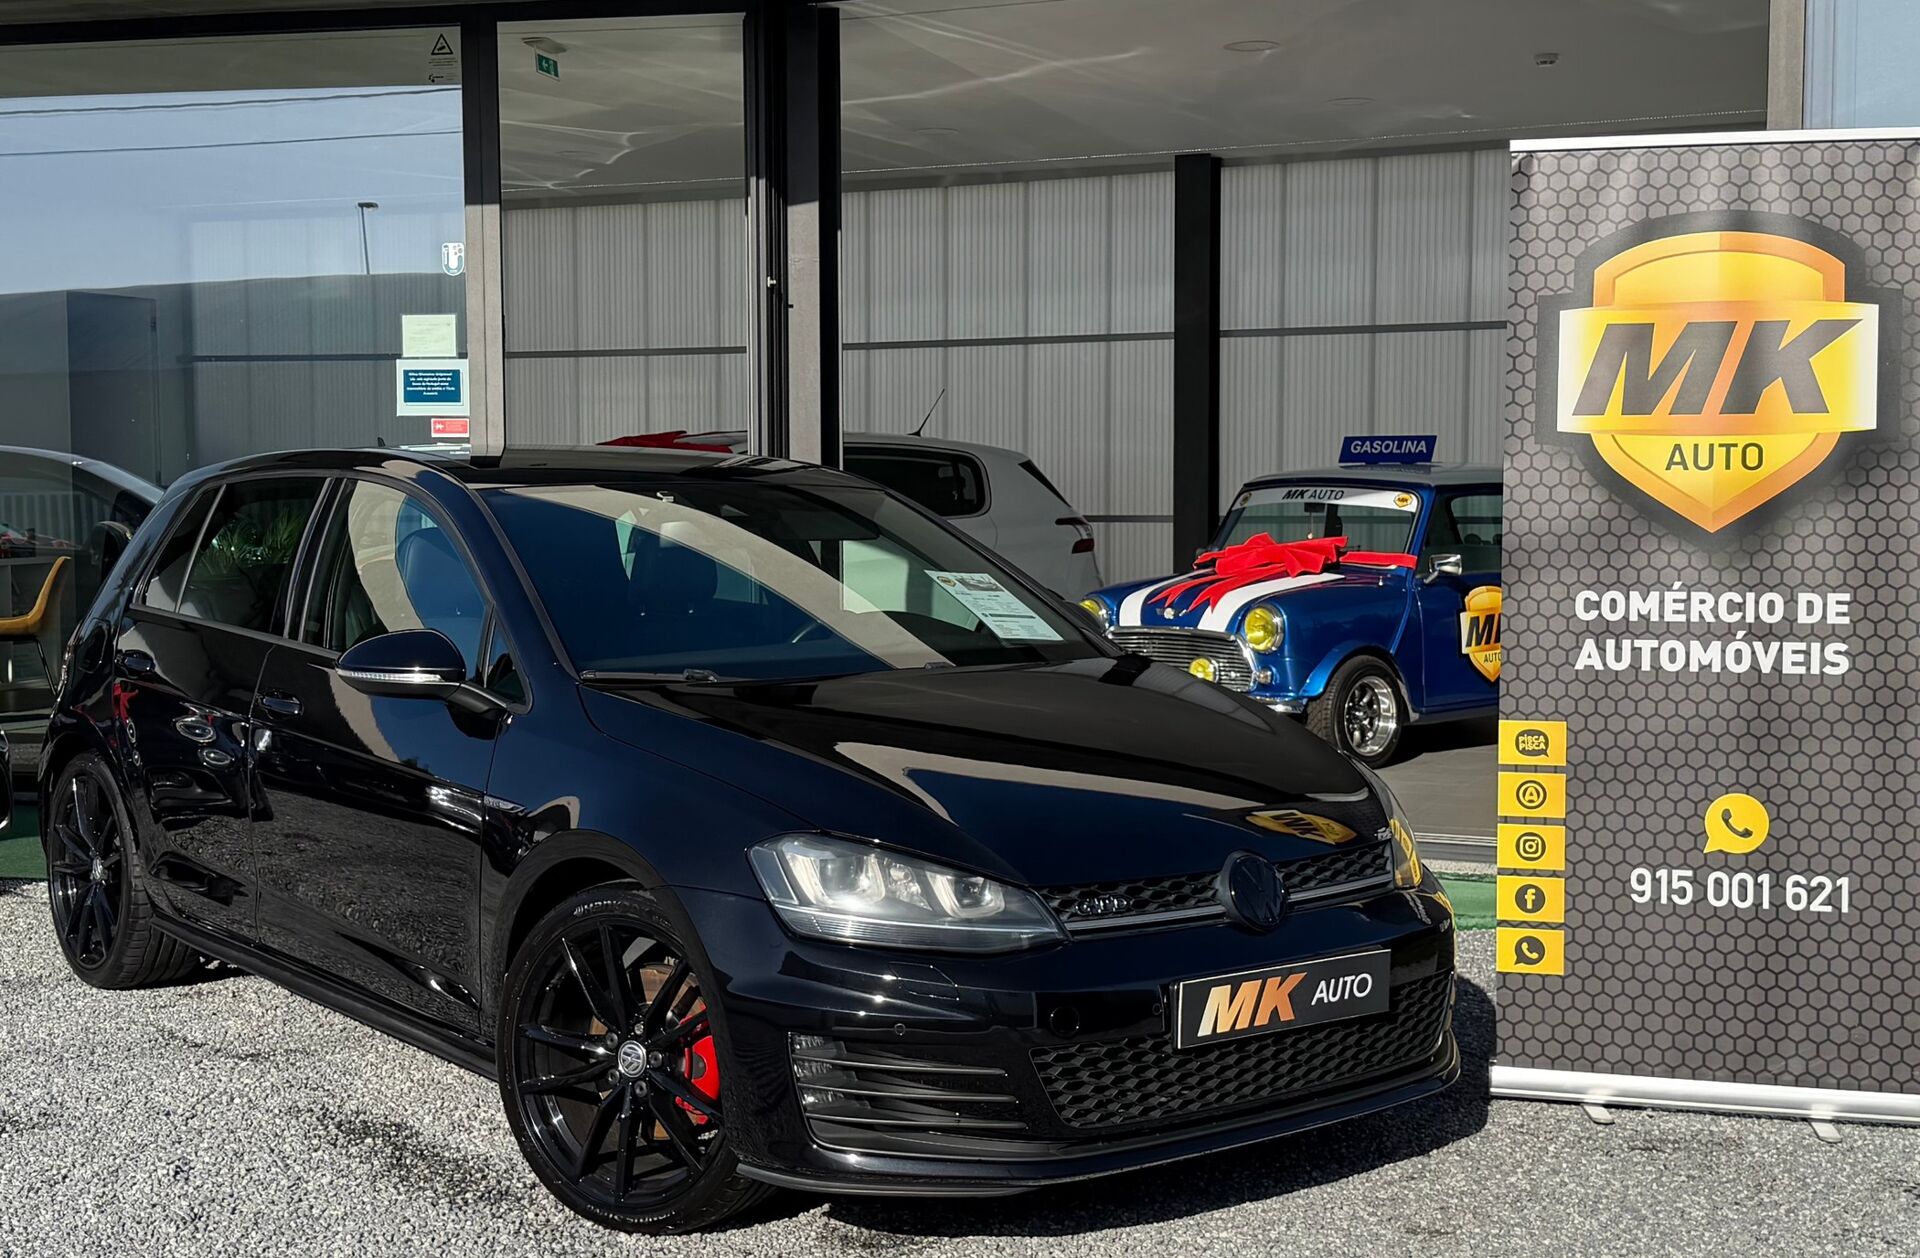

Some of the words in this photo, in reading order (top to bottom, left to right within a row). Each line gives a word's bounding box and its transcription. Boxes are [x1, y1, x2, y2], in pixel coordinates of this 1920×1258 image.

[1572, 318, 1863, 416] MK
[1350, 440, 1428, 454] GASOLINA
[1665, 442, 1765, 471] AUTO
[1282, 488, 1310, 500] MK
[1310, 489, 1345, 501] AUTO
[1574, 581, 1785, 625] COMÉRCIO
[1797, 592, 1852, 626] DE
[1574, 630, 1850, 676] AUTOMÓVEIS
[1630, 867, 1692, 906] 915
[1707, 870, 1771, 910] 001
[1785, 873, 1850, 914] 621
[1198, 972, 1307, 1037] MK
[1311, 972, 1373, 1006] AUTO
